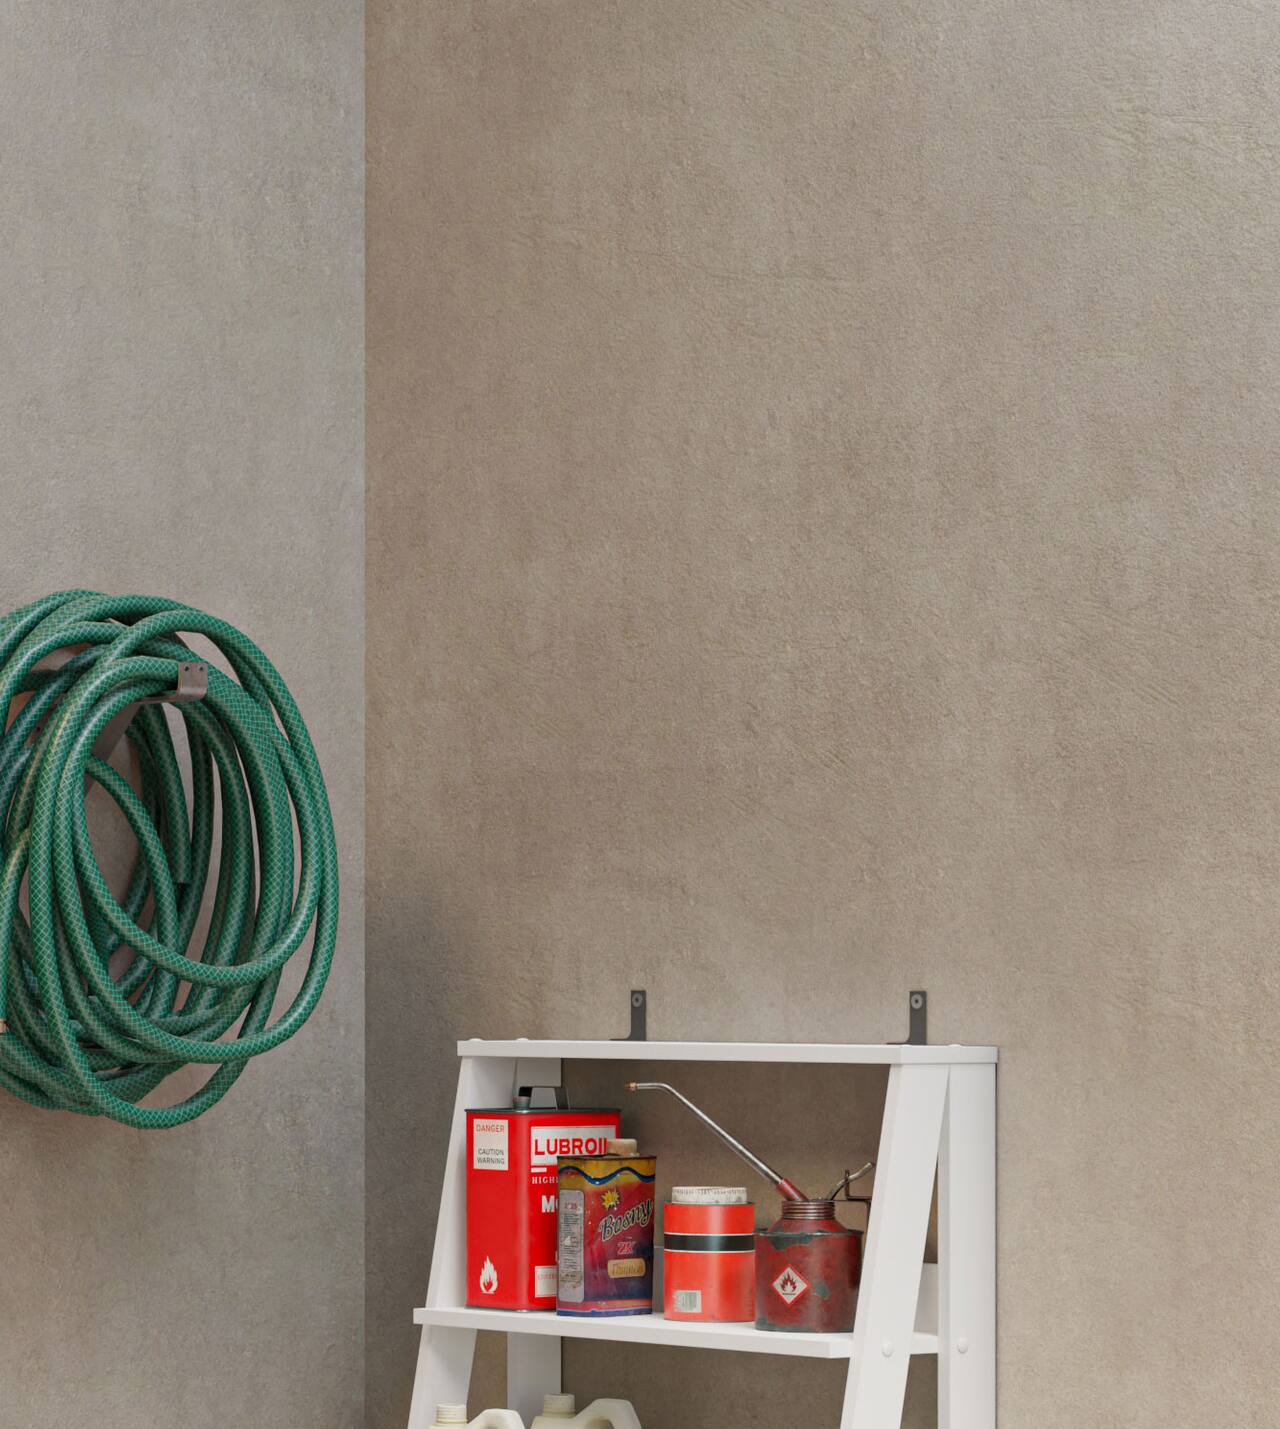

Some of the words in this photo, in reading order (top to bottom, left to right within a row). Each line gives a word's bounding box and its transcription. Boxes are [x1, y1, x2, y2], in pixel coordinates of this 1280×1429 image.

[476, 1124, 505, 1133] DANGER
[477, 1148, 505, 1156] CAUTION
[477, 1156, 505, 1165] WARNING
